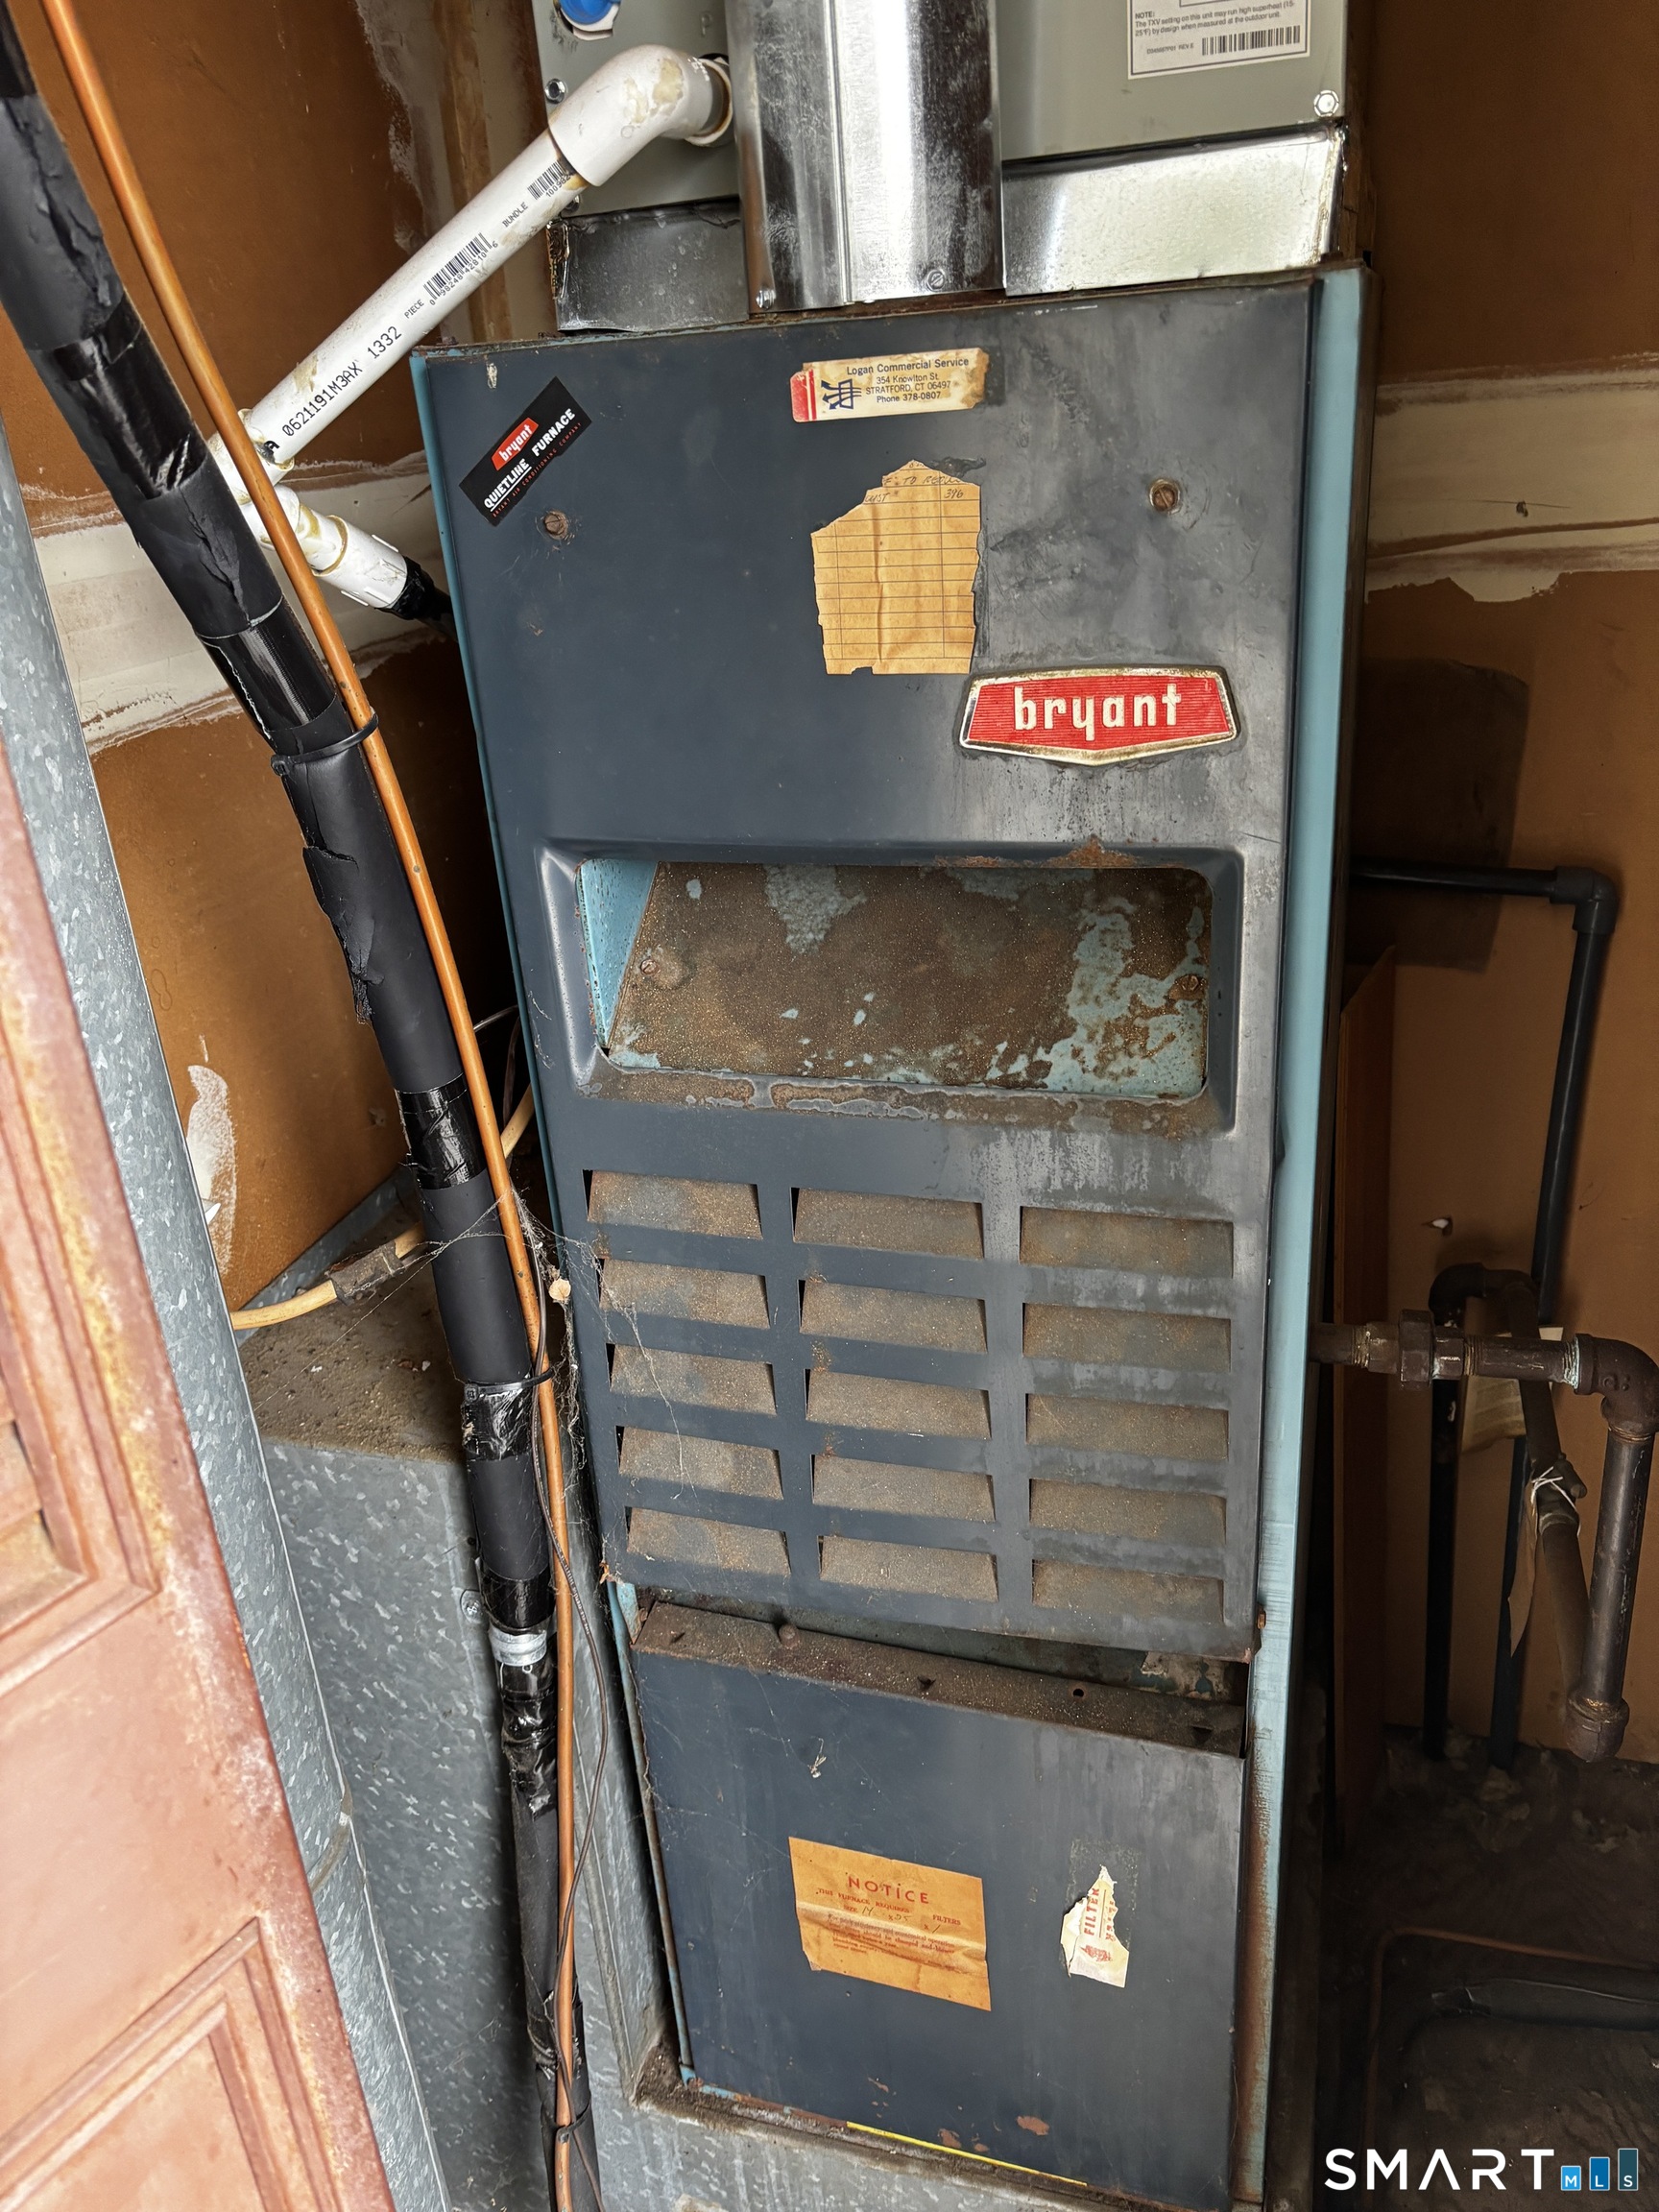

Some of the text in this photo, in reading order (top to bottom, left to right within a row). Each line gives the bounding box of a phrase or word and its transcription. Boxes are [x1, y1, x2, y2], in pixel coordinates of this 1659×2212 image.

[1135, 11, 1155, 19] NOTE:
[1160, 25, 1180, 34] design
[1197, 19, 1226, 29] measured
[1245, 12, 1267, 21] outdoor
[1238, 6, 1251, 14] high
[501, 202, 528, 228] BUNDLE
[441, 274, 463, 297] 98248
[465, 252, 487, 274] 42810
[404, 299, 424, 319] PIECE
[367, 325, 402, 359] 1332
[846, 357, 970, 376] Logan Commercial Service
[893, 373, 927, 383] Knowlton
[877, 391, 942, 403] Phone 378-0807
[915, 383, 925, 392] CT
[927, 380, 951, 390] 06497
[498, 423, 534, 462] bryant
[484, 408, 576, 509] QUIETLINE FURNACE
[1013, 683, 1182, 741] bryant
[848, 1875, 929, 1904] NOTICE
[818, 1887, 961, 1926] THIS FURNACE REQUIRES FILTERS
[1083, 1887, 1100, 1936] FILTER
